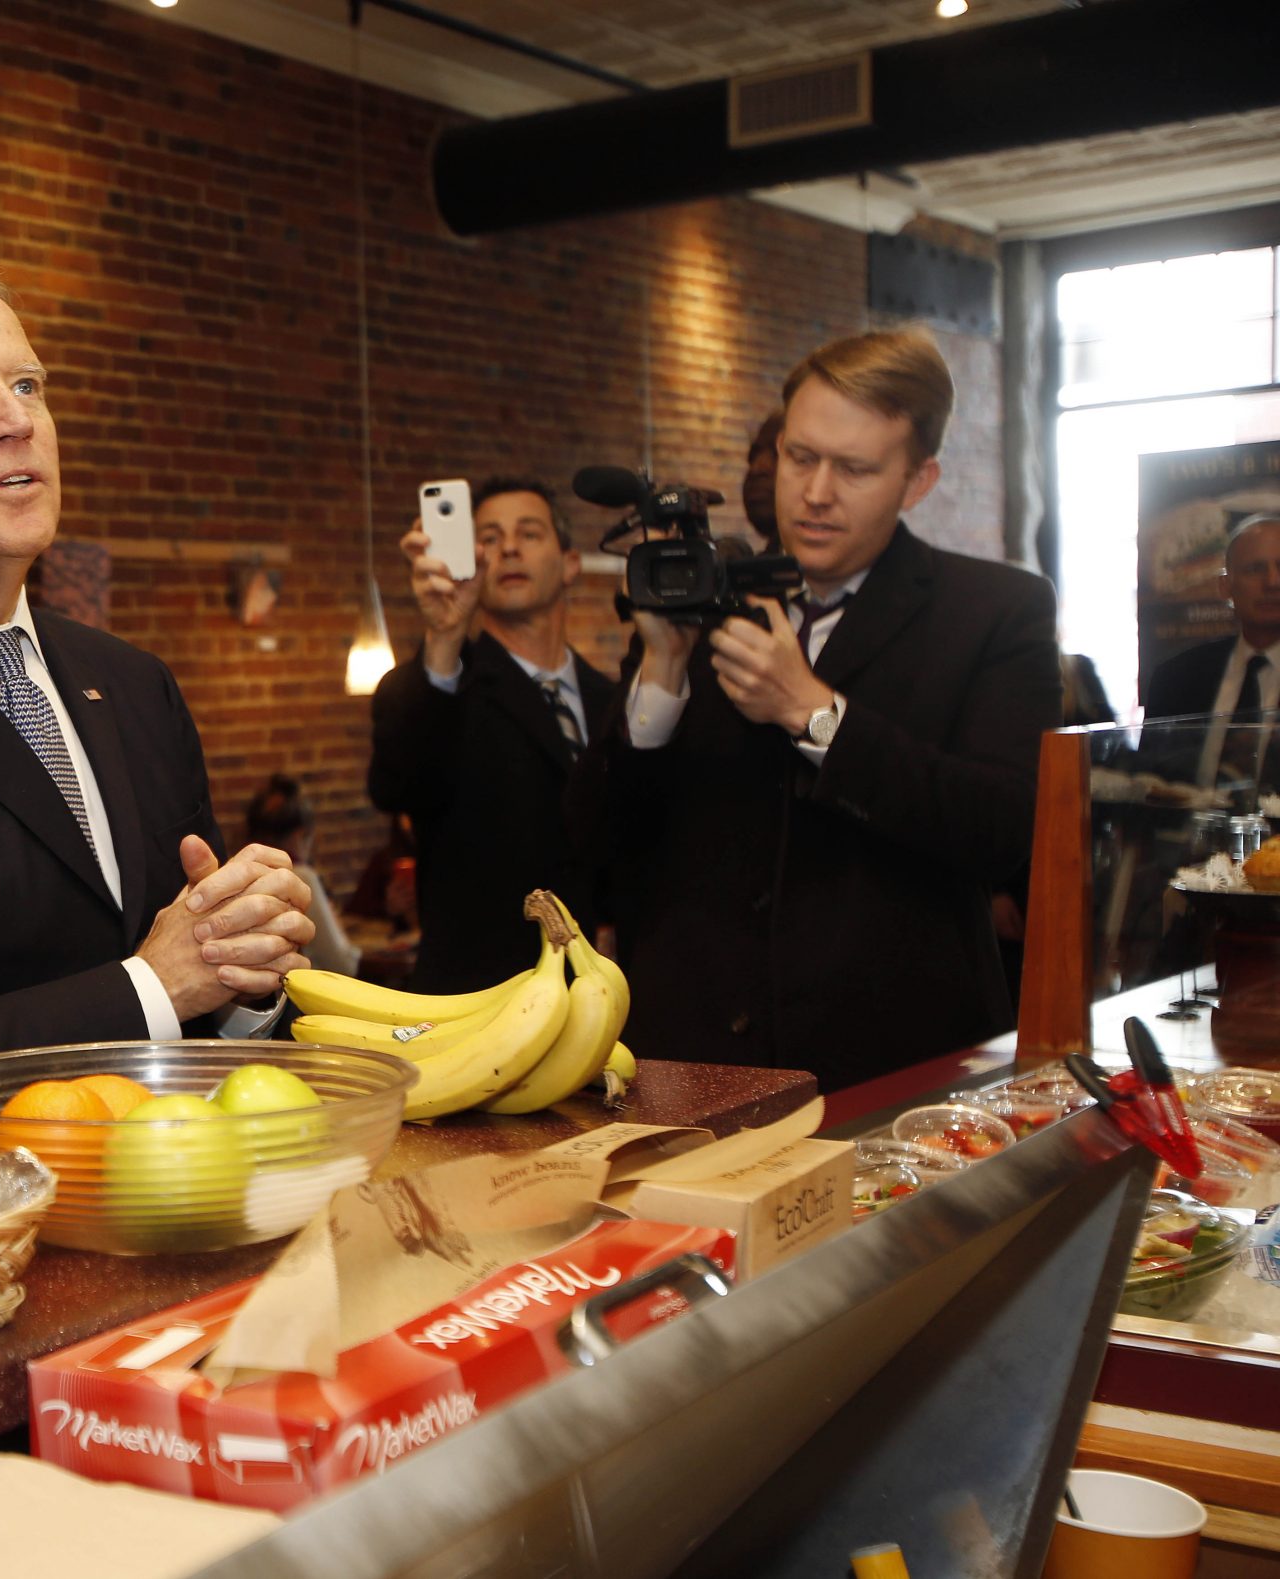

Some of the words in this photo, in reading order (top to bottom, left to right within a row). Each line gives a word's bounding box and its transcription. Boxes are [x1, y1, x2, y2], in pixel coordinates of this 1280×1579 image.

[411, 1261, 622, 1349] MarketWax
[40, 1400, 204, 1466] MarketWax
[338, 1389, 480, 1477] MarketWax
